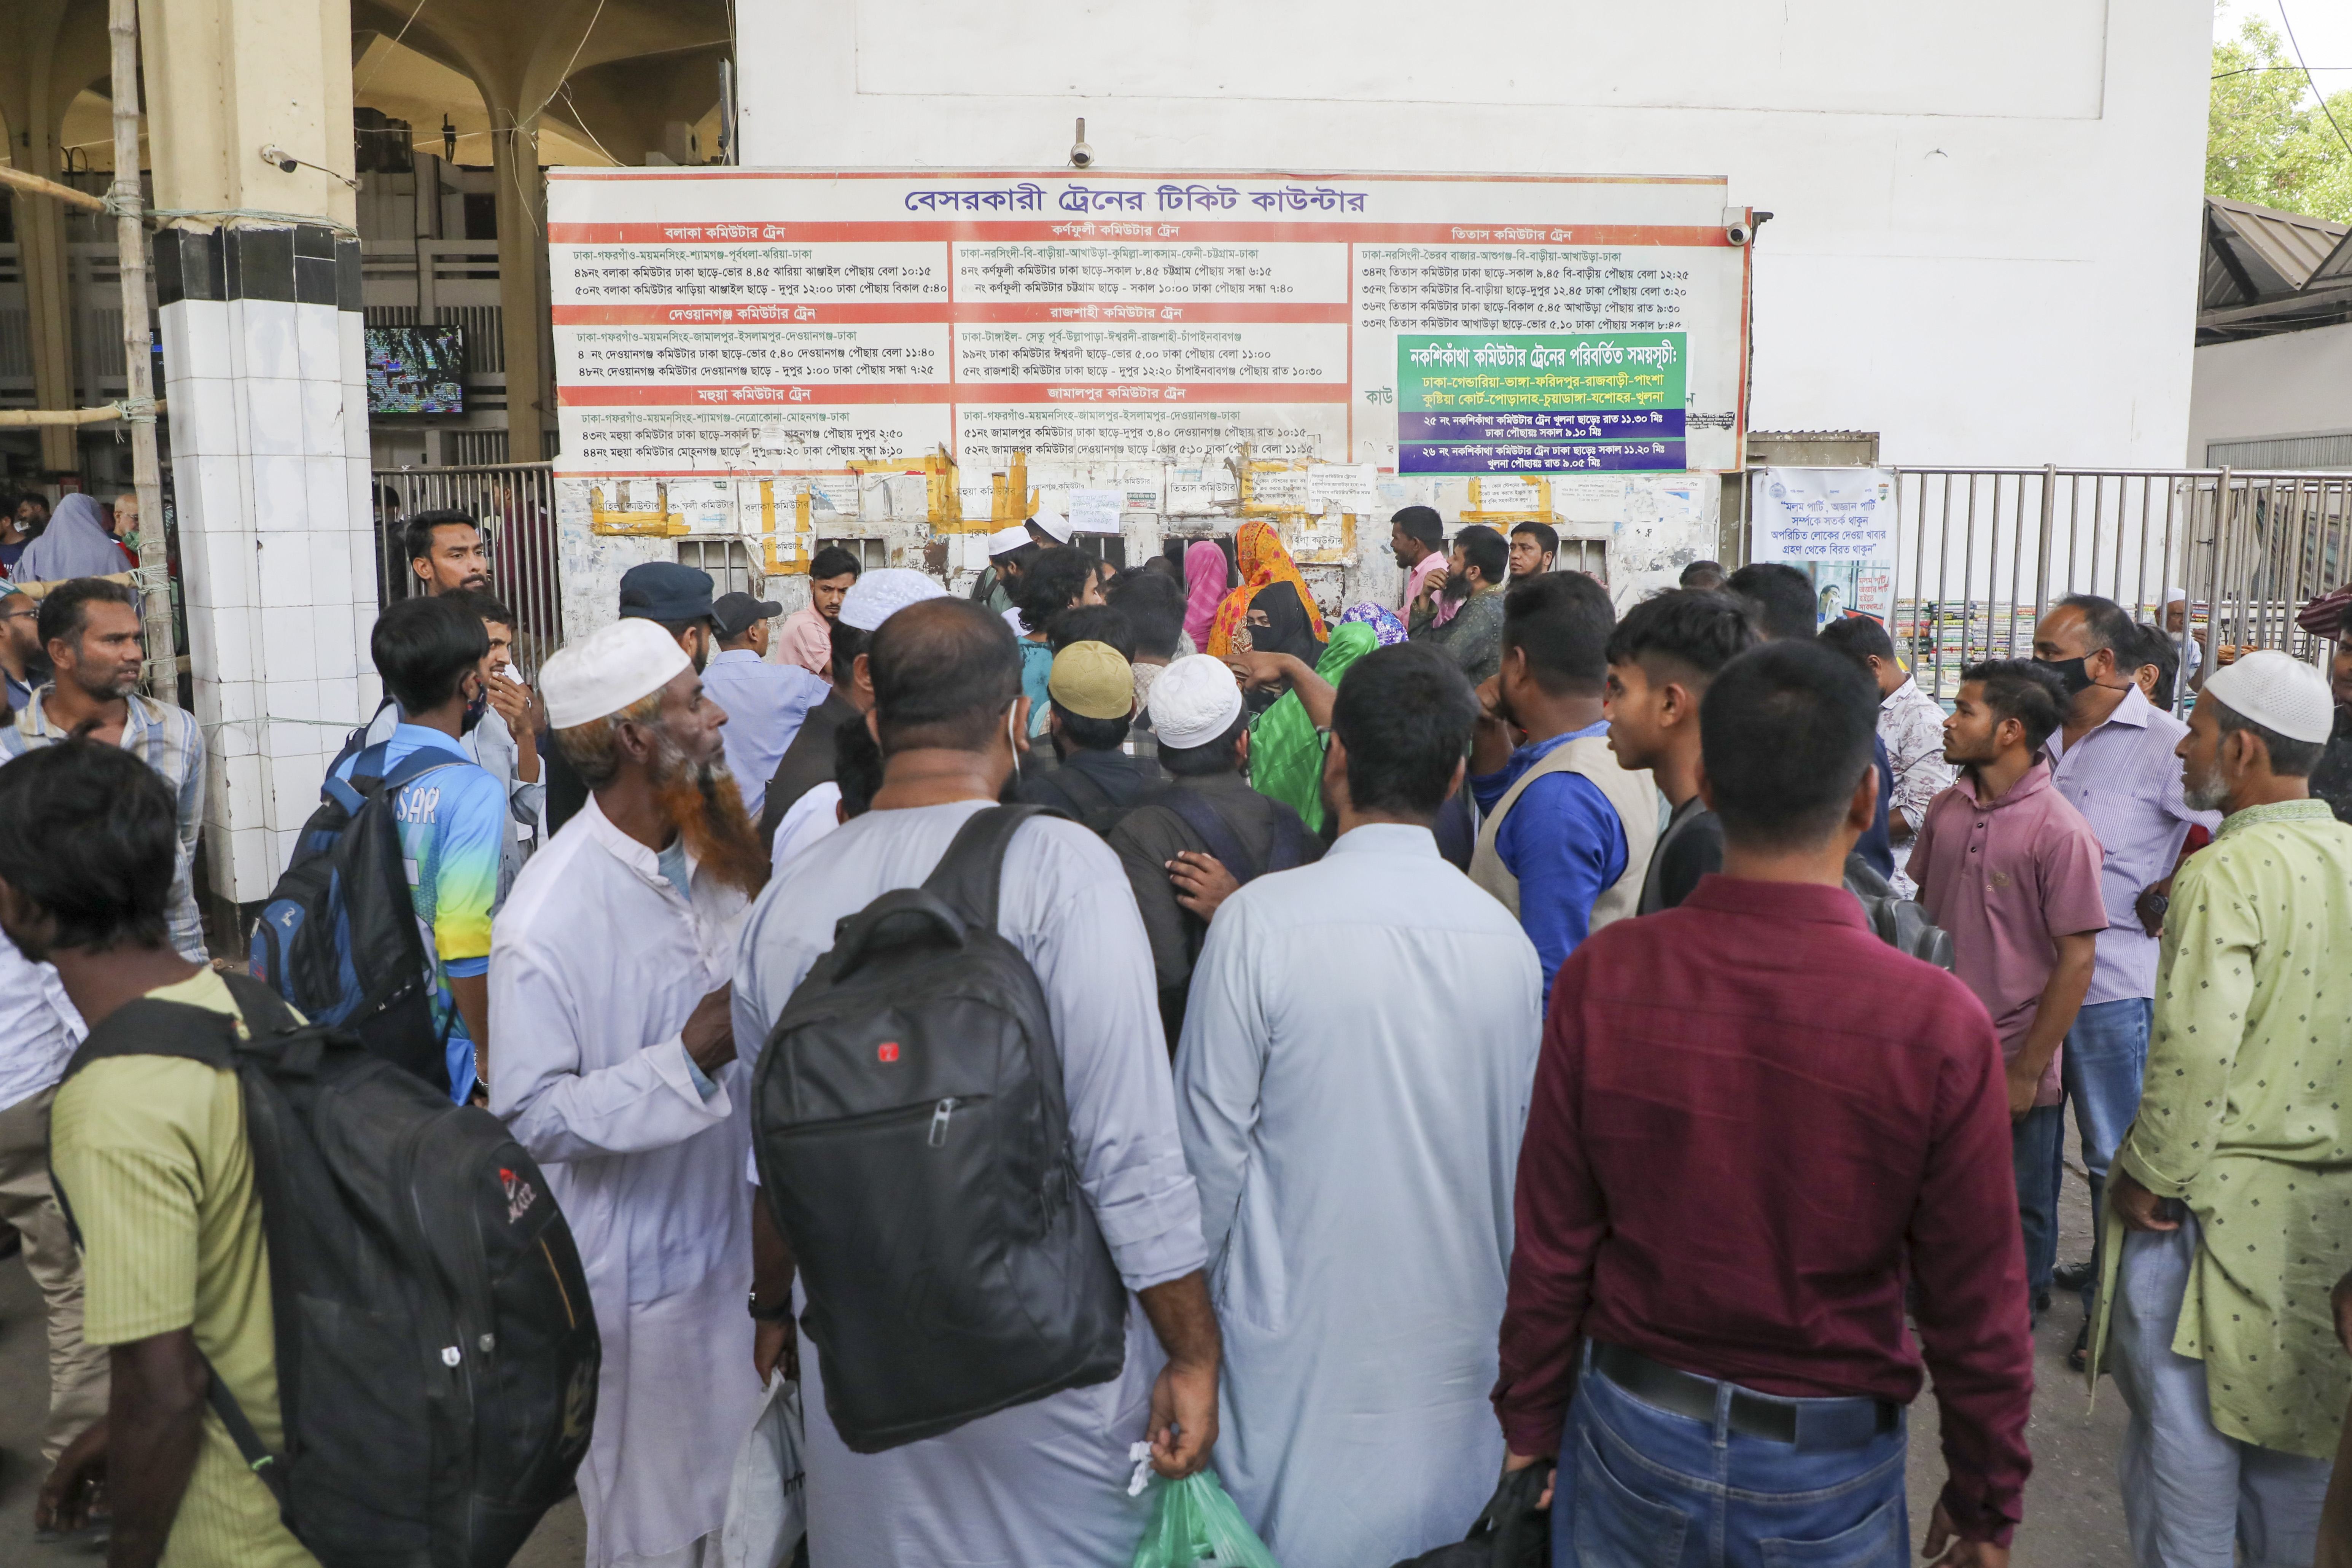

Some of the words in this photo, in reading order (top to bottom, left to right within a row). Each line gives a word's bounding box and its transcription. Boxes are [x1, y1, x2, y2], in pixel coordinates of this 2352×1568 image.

[905, 183, 1047, 212] বেসরকারী
[1059, 183, 1147, 214] ট্রেনের
[1154, 185, 1241, 212] টিকিট
[1248, 185, 1369, 213] কাউন্টার
[664, 227, 702, 239] বলাকা
[705, 224, 759, 239] কমিউটার
[763, 224, 786, 240] ট্রেন
[1052, 221, 1096, 238] কর্ণফুলী
[1099, 222, 1153, 236] কমিউটার
[1158, 223, 1180, 237] ট্রেন
[1451, 227, 1490, 240] তিতাস
[1493, 228, 1546, 240] কমিউটার
[1551, 228, 1572, 242] ট্রেন
[602, 268, 630, 278] বলাকা
[632, 266, 672, 277] কমিউটার
[675, 268, 694, 277] ঢাকা
[773, 264, 802, 276] ঝারিয়া
[805, 265, 841, 277] ঝাঞ্জাইল
[845, 264, 875, 277] পৌছায়
[878, 266, 898, 276] বেলা
[1389, 265, 1418, 277] তিতাস
[1420, 265, 1459, 277] কমিউটার
[1462, 268, 1482, 278] ঢাকা
[1605, 267, 1634, 280] পৌছায়
[1637, 270, 1657, 279] বেলা
[669, 308, 732, 320] দেওয়ানগঞ্জ
[794, 305, 817, 321] ট্রেন
[1050, 304, 1100, 319] রাজশাহী
[1102, 305, 1156, 318] কমিউটার
[1161, 306, 1182, 320] ট্রেন
[1409, 343, 1470, 368] নকশিকাঁথা
[1473, 343, 1527, 367] কমিউটার
[1531, 342, 1566, 370] ট্রেনের
[1570, 341, 1624, 366] পরিবর্তিত
[697, 389, 728, 403] মহুয়া
[731, 386, 785, 400] কমিউটার
[789, 386, 812, 401] ট্রেন
[1047, 388, 1103, 401] জামালপুর
[1106, 386, 1160, 398] কমিউটার
[1164, 386, 1186, 400] ট্রেন
[1439, 417, 1450, 426] নং
[1452, 414, 1494, 425] নকশিকাঁথা
[1496, 414, 1533, 425] কমিউটার
[1535, 414, 1551, 426] ট্রেন
[1553, 415, 1575, 427] খুলনা
[1602, 415, 1619, 423] রাত
[1485, 429, 1504, 438] ঢাকা
[1539, 428, 1563, 437] সকাল
[1439, 448, 1450, 457] নং
[1451, 444, 1493, 456] নকশিকাঁথা
[1494, 444, 1532, 455] কমিউটার
[1534, 444, 1550, 457] ট্রেন
[1552, 446, 1571, 455] ঢাকা
[1598, 446, 1622, 454] সকাল
[1487, 459, 1509, 470] খুলনা
[1544, 459, 1561, 468] রাত
[980, 485, 1016, 496] কমিউটার
[1170, 482, 1197, 493] তিতাস
[1199, 482, 1236, 492] কমিউটার
[700, 500, 734, 510] কমিউটার
[745, 502, 771, 512] বলাকা
[773, 500, 809, 510] কমিউটার
[1831, 502, 1857, 511] অজ্ঞান
[1860, 499, 1876, 511] পার্টি
[1823, 514, 1845, 525] সতর্ক
[1848, 516, 1868, 527] থাকুন
[967, 529, 989, 538] পুরুষ
[1771, 528, 1808, 540] অপরিচিত
[1811, 531, 1840, 540] লোকের
[1842, 531, 1864, 540] দেওয়া
[1867, 530, 1886, 539] খাবার
[775, 541, 804, 550] কমিউটার
[1782, 545, 1802, 555] গ্রহণ
[1805, 545, 1827, 555] থেকে
[1829, 543, 1850, 554] বিরত
